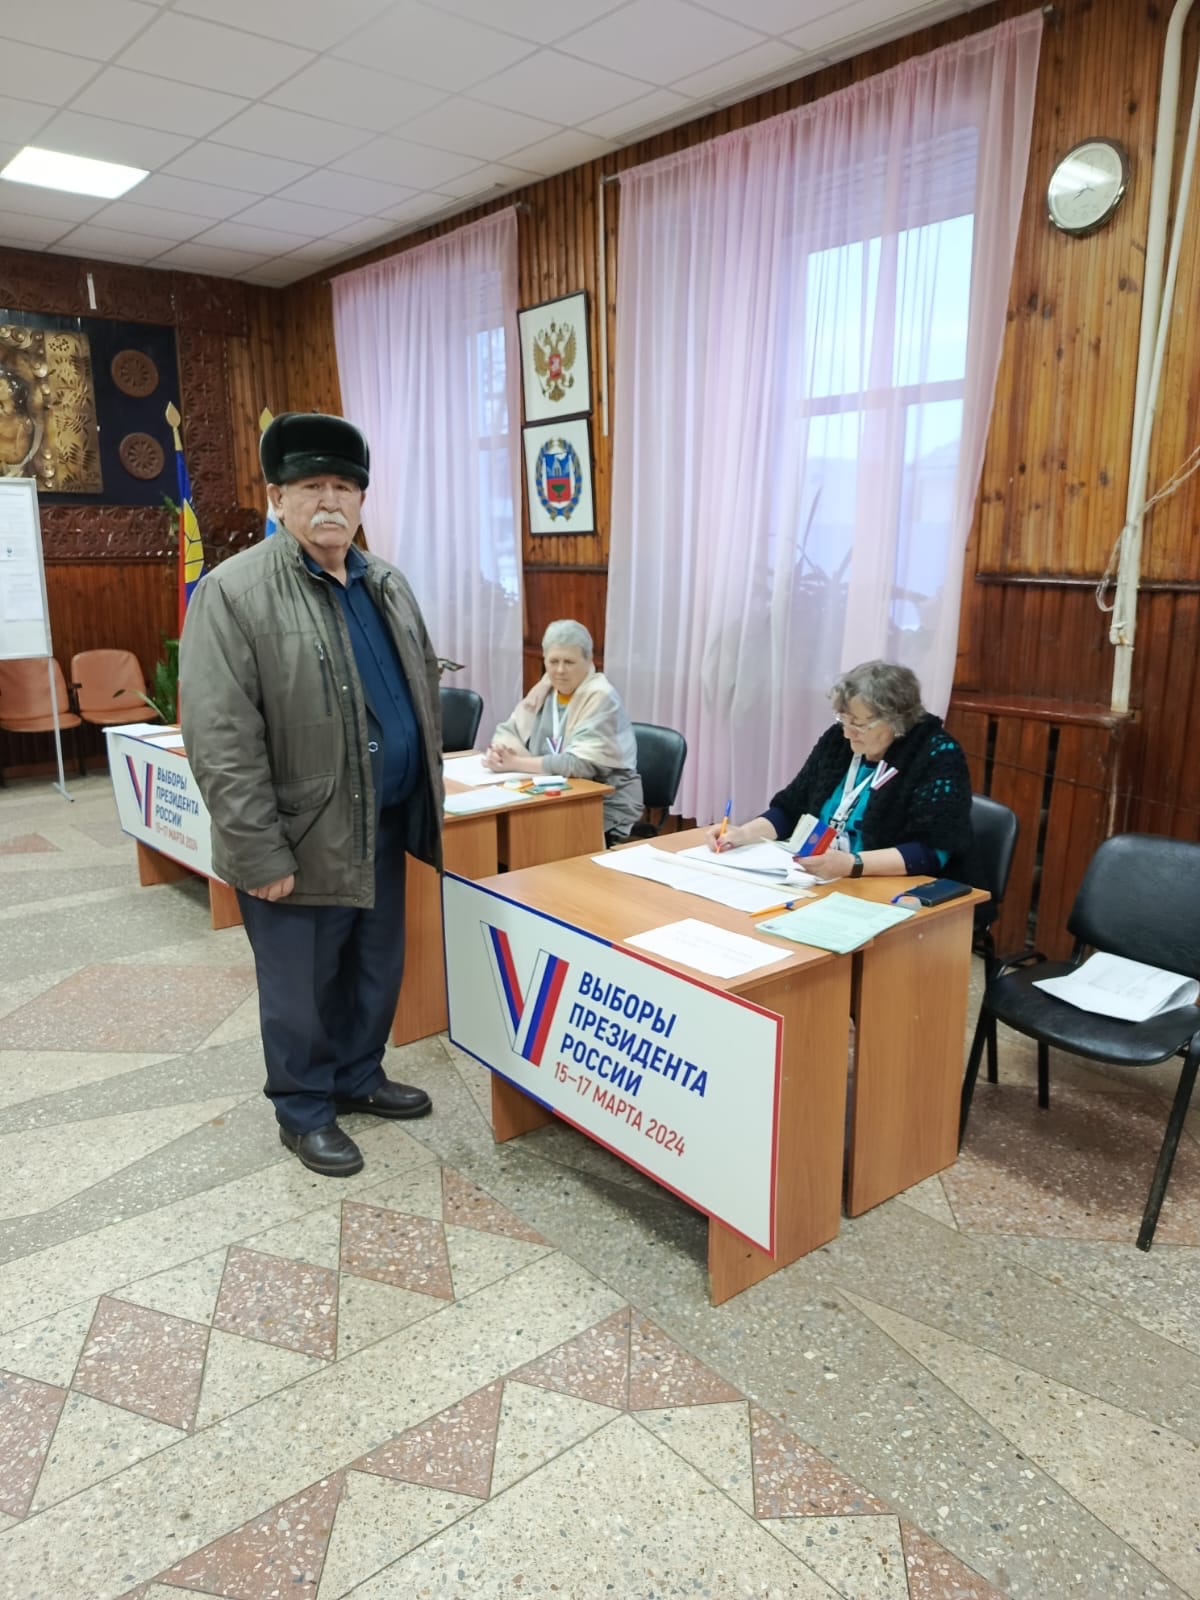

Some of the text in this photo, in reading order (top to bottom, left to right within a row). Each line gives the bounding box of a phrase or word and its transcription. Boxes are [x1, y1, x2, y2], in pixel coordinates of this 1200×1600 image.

[156, 786, 199, 816] ПРЕЗИДЕНТА
[157, 767, 187, 791] ВЫБОРЫ
[156, 804, 182, 828] РОССИИ
[578, 971, 677, 1038] ВЫБОРЫ
[560, 1033, 643, 1097] РОССИИ
[568, 1002, 708, 1098] ПРЕЗИДЕНТА
[592, 1085, 643, 1131] МАРТА
[645, 1118, 686, 1157] 2024
